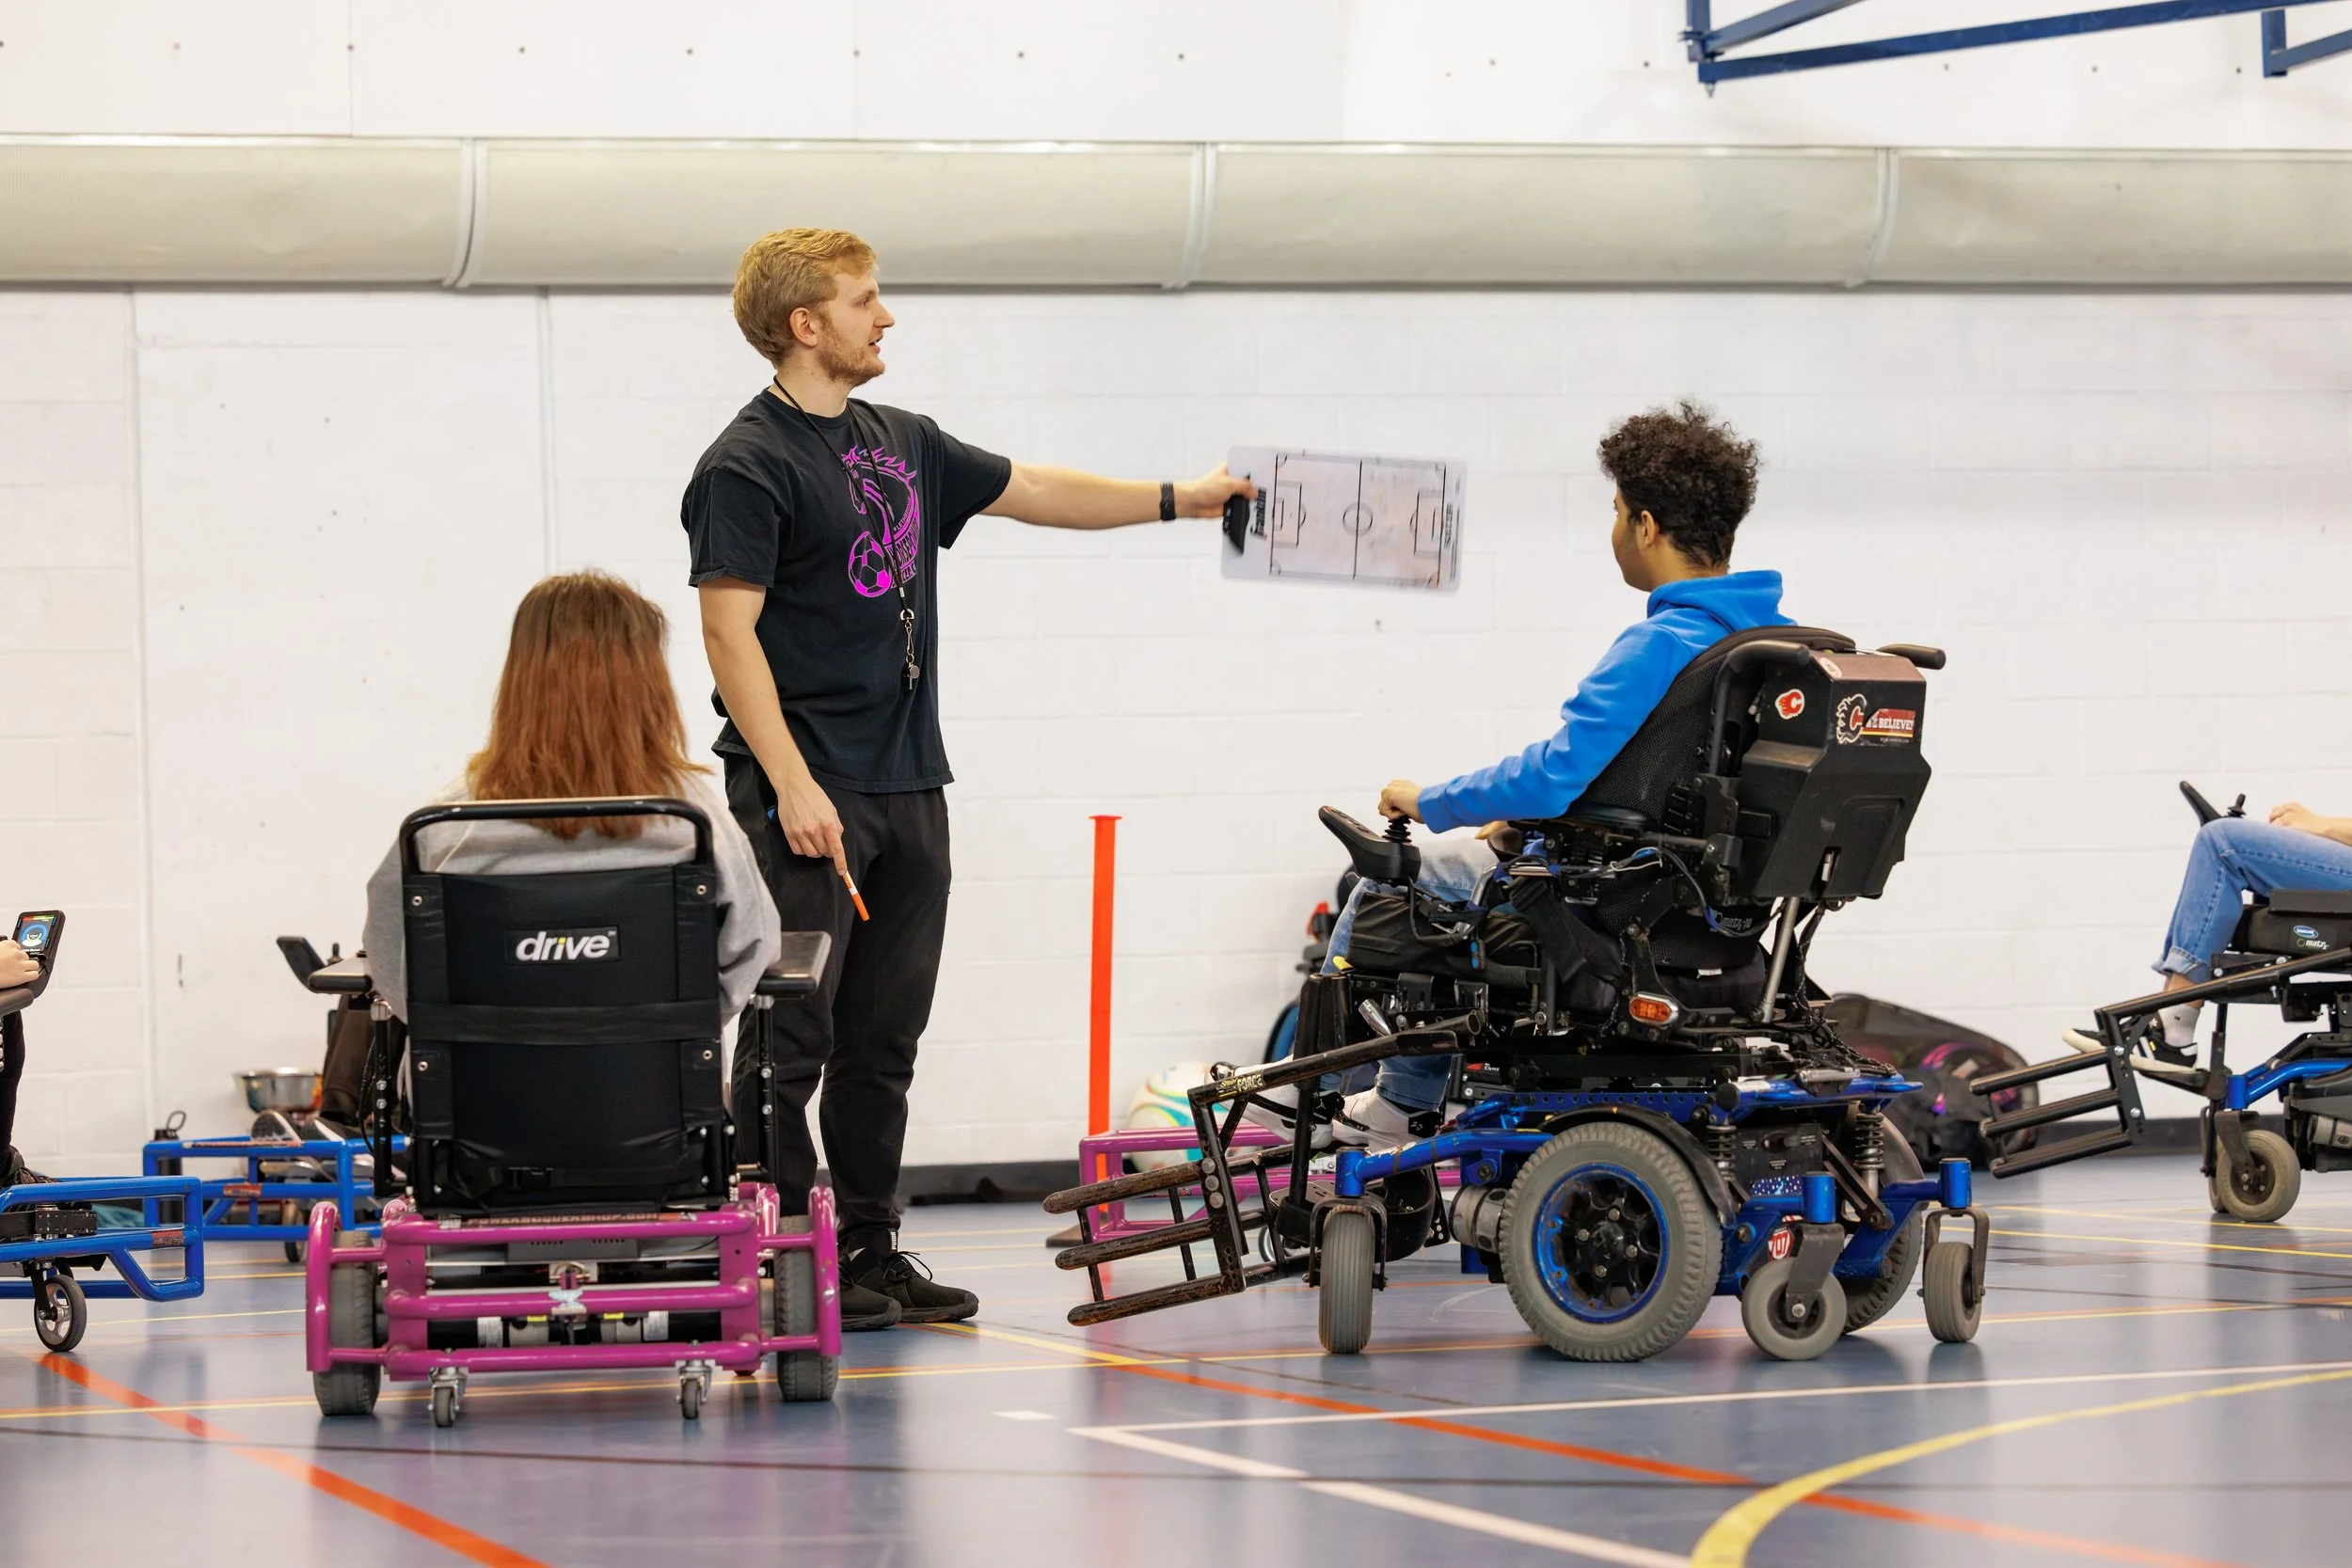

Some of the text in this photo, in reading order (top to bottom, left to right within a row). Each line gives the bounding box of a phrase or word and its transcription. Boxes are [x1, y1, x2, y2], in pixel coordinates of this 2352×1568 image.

[1879, 718, 1915, 731] BELIEVE!
[516, 931, 611, 961] drive
[1236, 1073, 1263, 1092] FORCE
